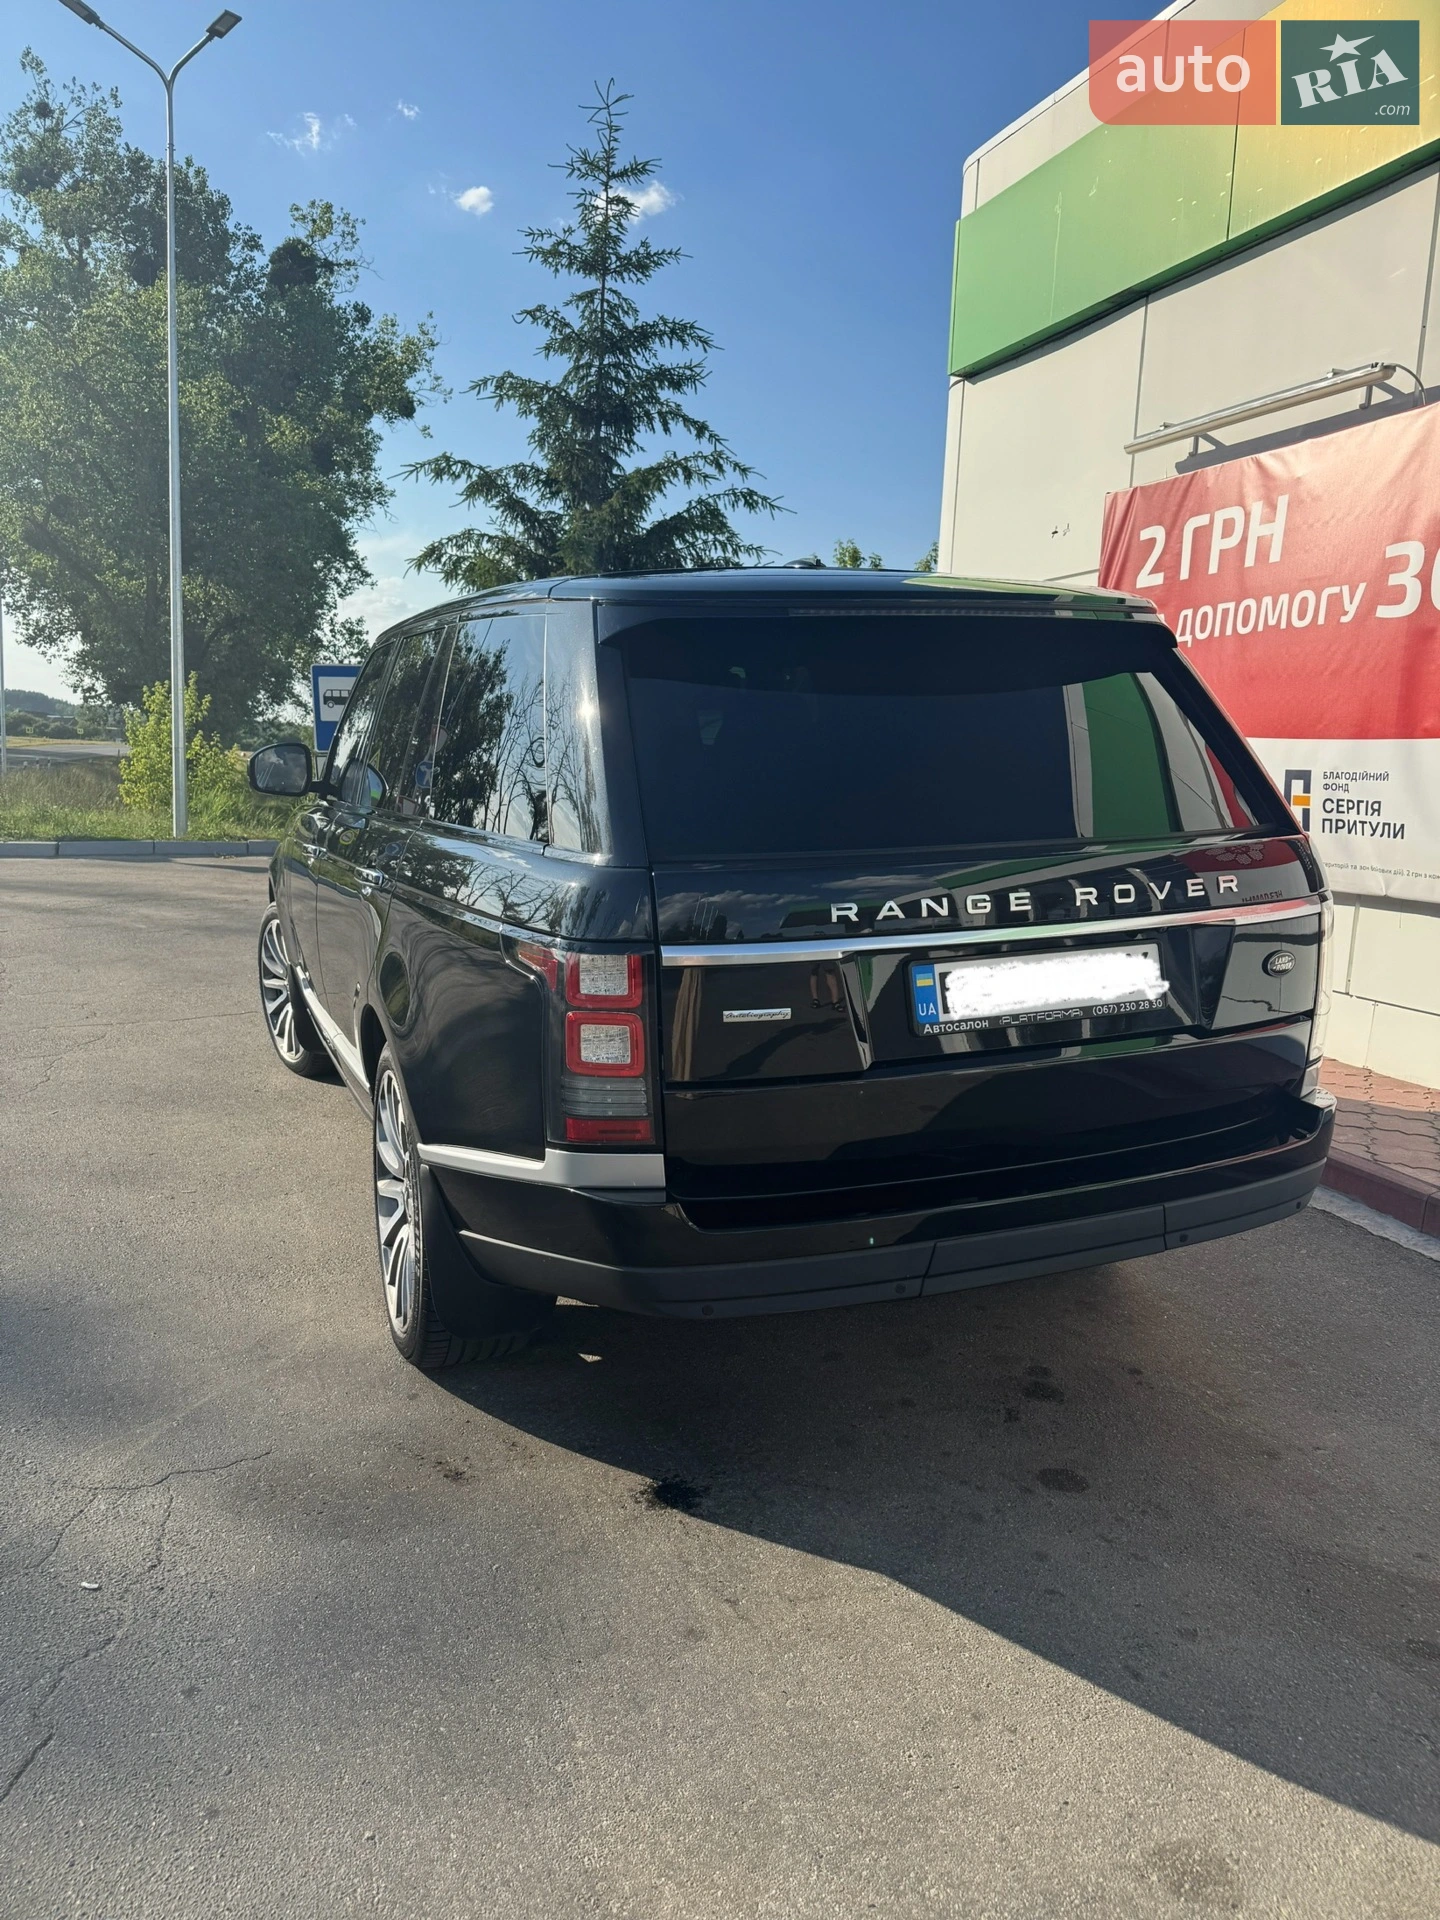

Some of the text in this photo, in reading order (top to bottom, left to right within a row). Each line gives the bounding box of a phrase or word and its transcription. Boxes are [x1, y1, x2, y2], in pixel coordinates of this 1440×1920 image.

[1136, 494, 1289, 589] 2 ГРН
[1175, 582, 1367, 648] ДОПОМОГУ
[1322, 771, 1390, 783] БЛАГОДІЙНИЙ
[1322, 783, 1350, 793] ФОНД
[1322, 798, 1382, 817] СЕРГІЯ
[1322, 818, 1405, 840] ПРИТУЛИ
[831, 875, 1241, 923] RANGE ROVER
[918, 1002, 937, 1016] UA
[923, 1019, 989, 1034] Автосалон
[1092, 1004, 1119, 1017] (067)
[1120, 1002, 1136, 1013] 230
[1138, 1000, 1150, 1011] 28
[1151, 998, 1164, 1009] 30
